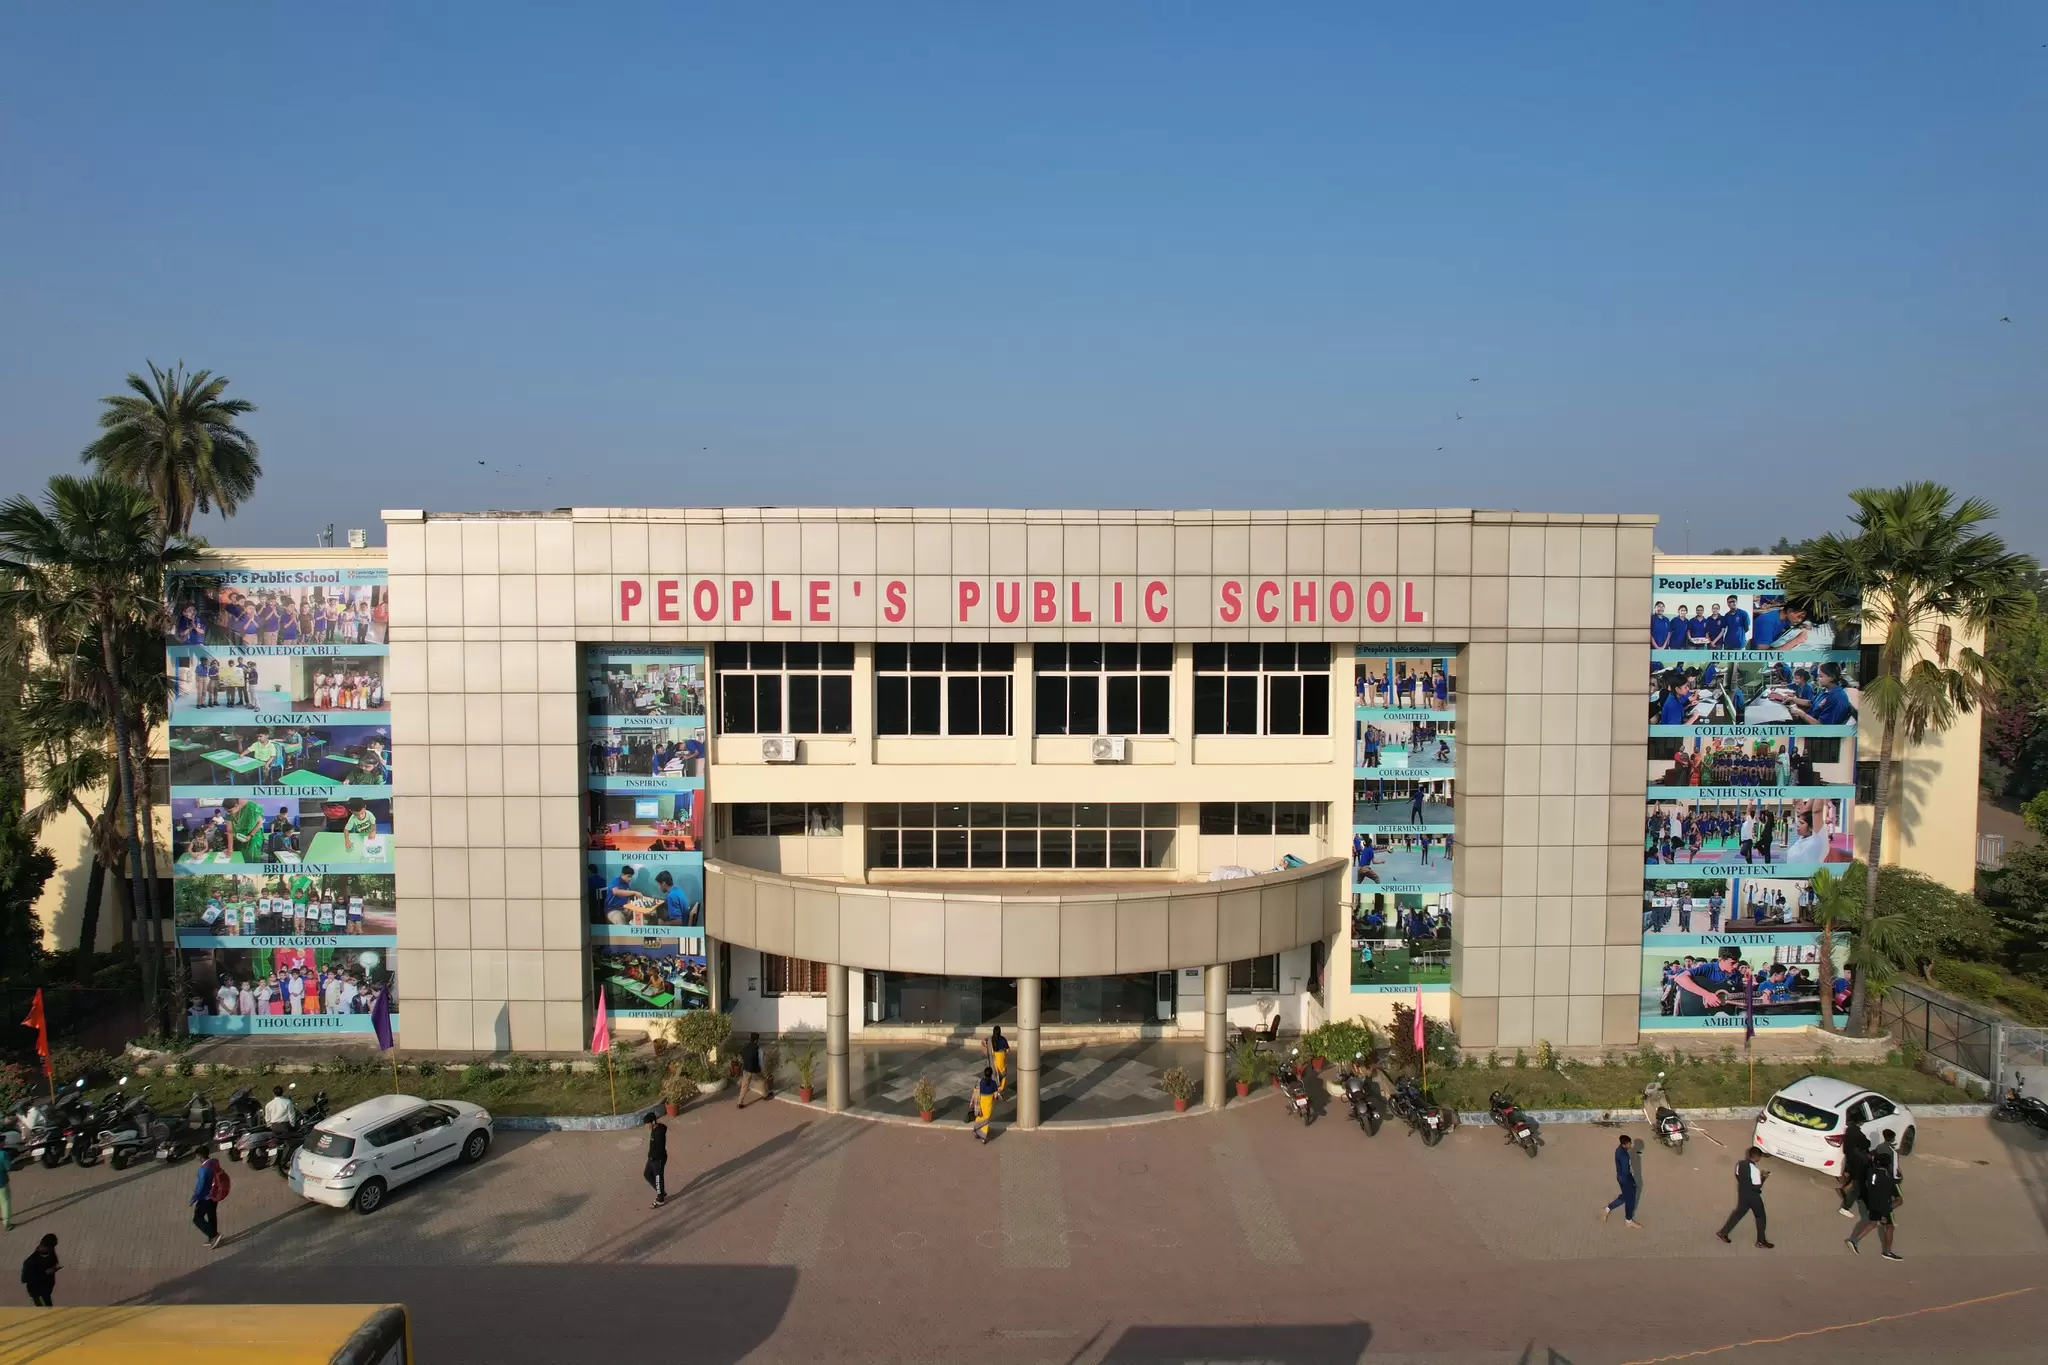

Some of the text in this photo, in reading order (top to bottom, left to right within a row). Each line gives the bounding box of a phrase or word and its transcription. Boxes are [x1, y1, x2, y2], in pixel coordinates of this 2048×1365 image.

[251, 572, 292, 583] Public
[295, 570, 340, 583] School
[1659, 578, 1787, 592] People's Public Scho
[620, 580, 1429, 622] PEOPLE'S PUBLIC SCHOOL
[230, 646, 340, 656] KNOWLEDGEABLE
[600, 648, 628, 656] People's
[1363, 646, 1388, 655] People's
[1712, 652, 1784, 661] REFLECTIVE
[255, 714, 328, 724] COGNIZANT
[1694, 726, 1795, 736] COLLABORATIVE
[253, 786, 335, 796] INTELLIGENT
[1699, 788, 1786, 797] ENTHUSIASTIC
[264, 864, 329, 874] BRILLIANT
[1702, 866, 1776, 875] COMPETENT
[251, 936, 337, 946] COURAGEOUS
[1701, 935, 1775, 944] INNOVATIVE
[256, 1018, 343, 1028] THOUGHTFUL
